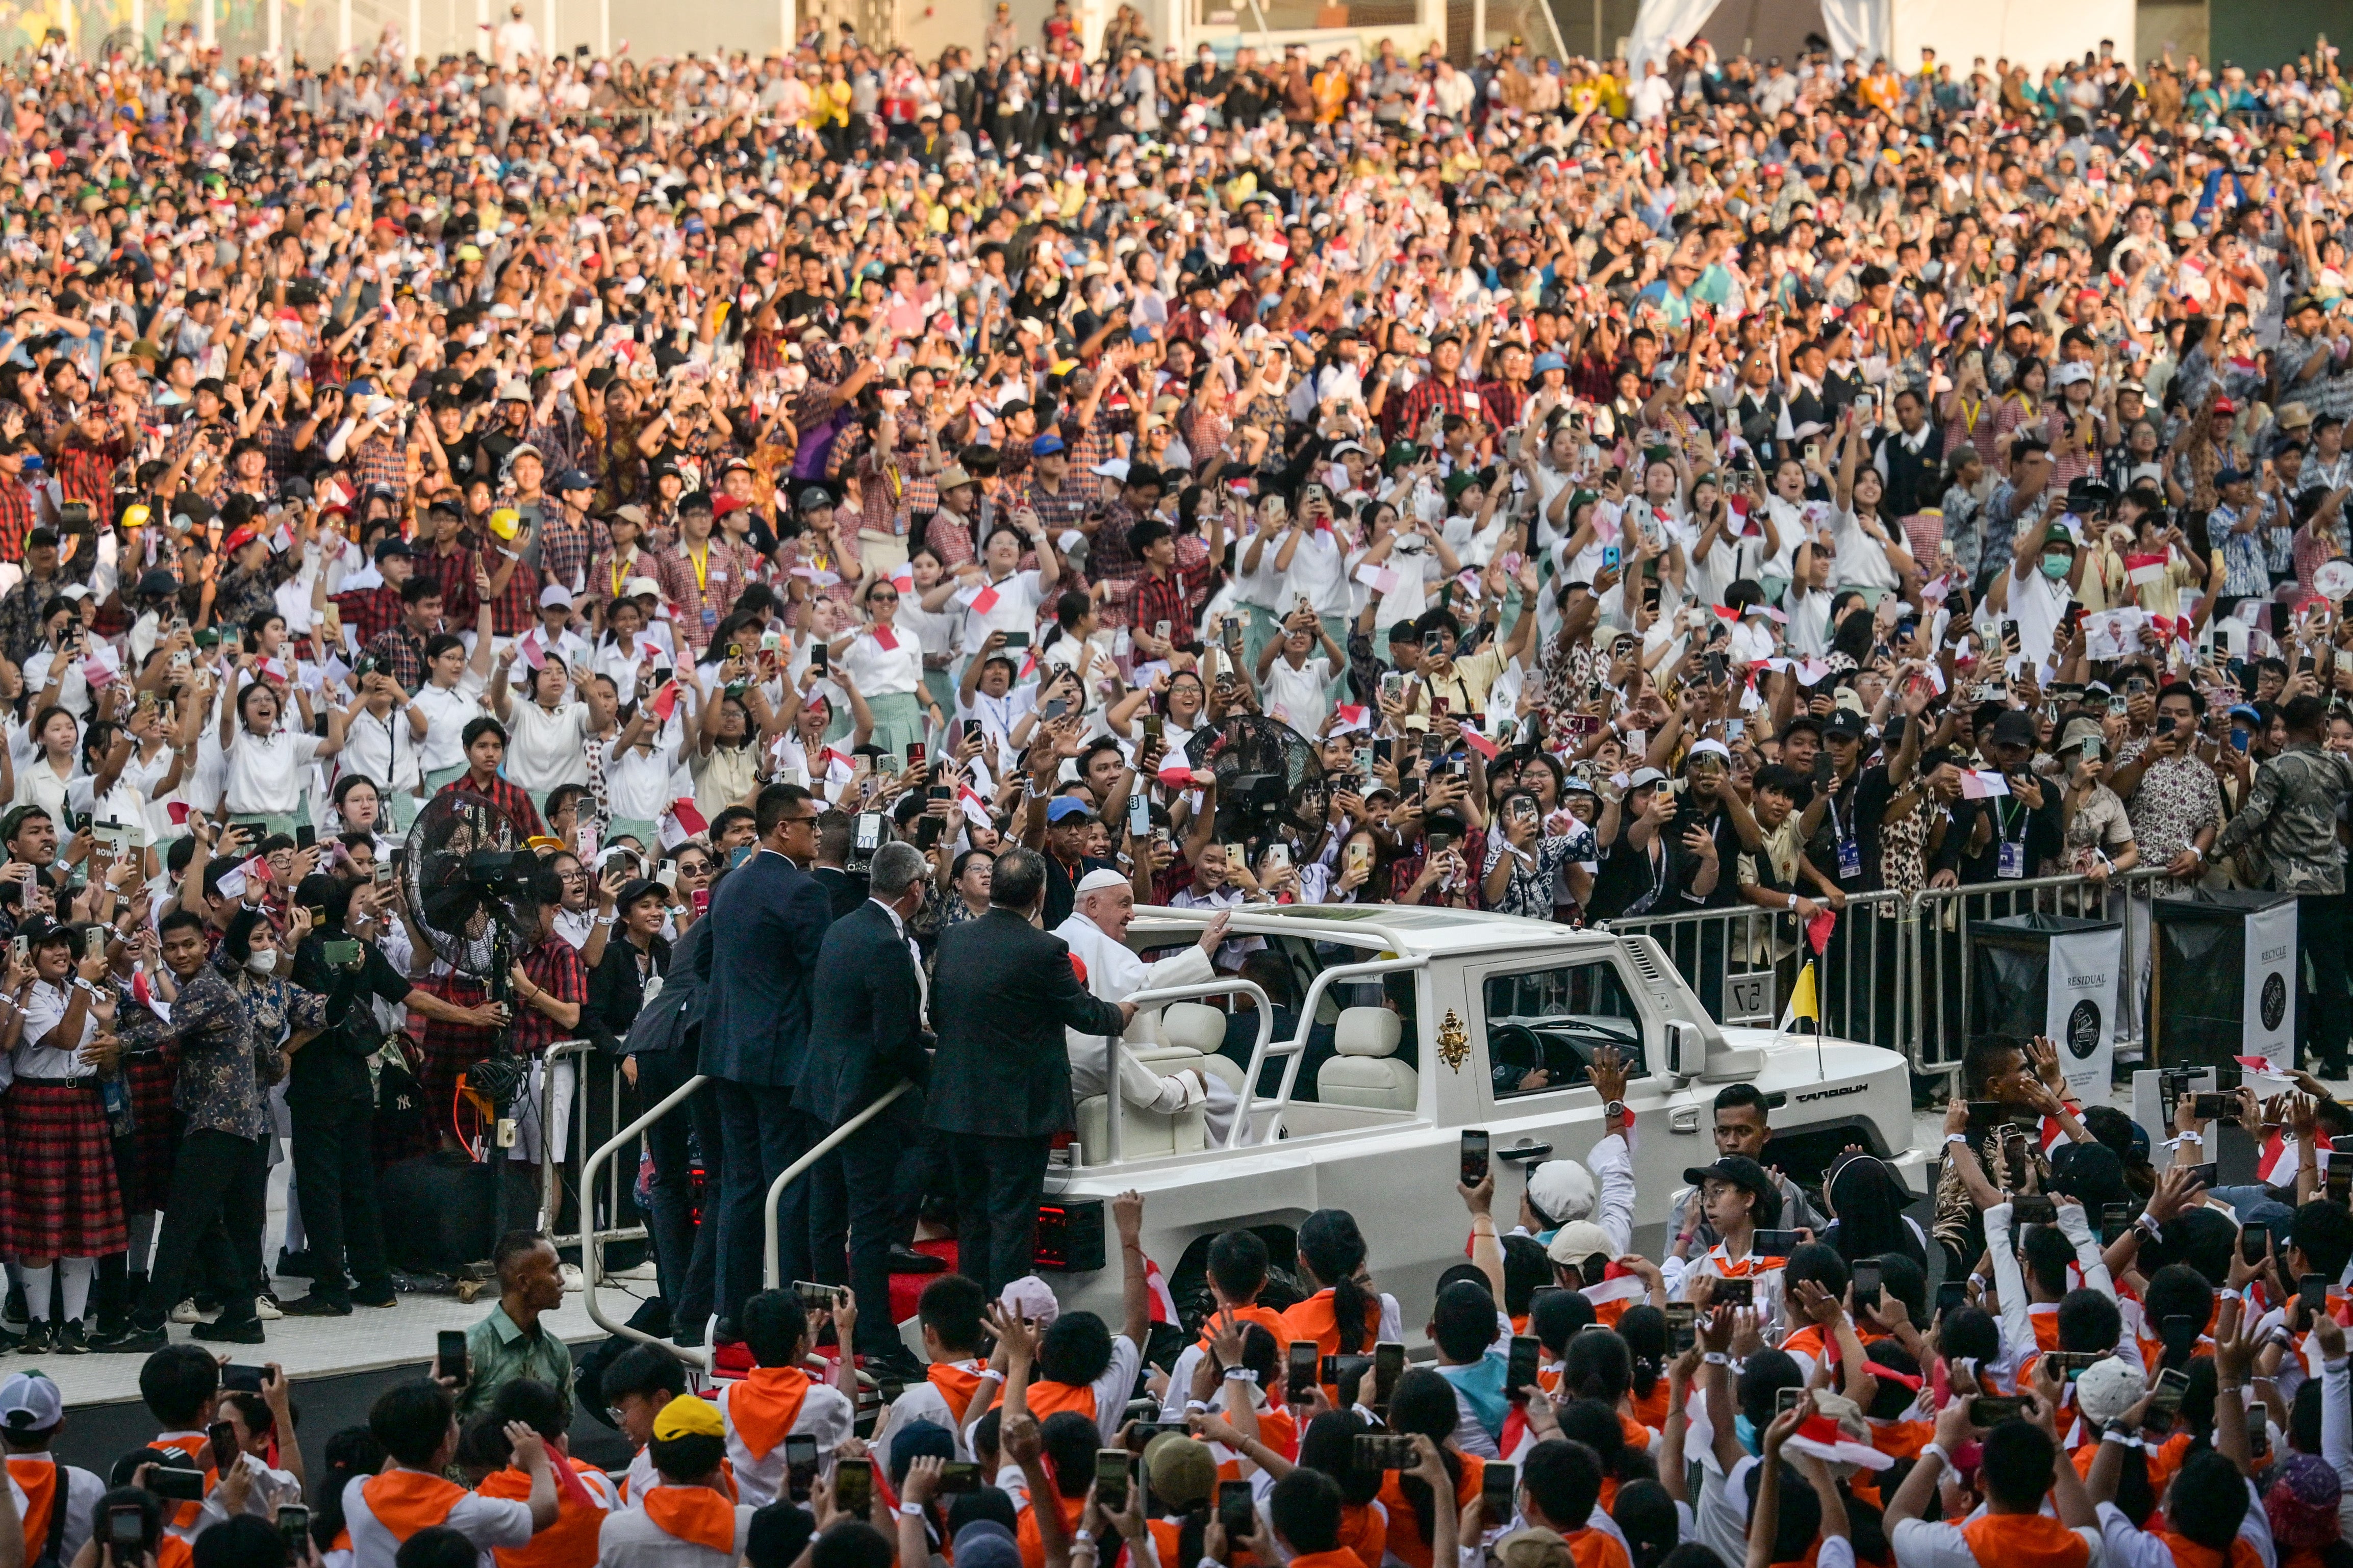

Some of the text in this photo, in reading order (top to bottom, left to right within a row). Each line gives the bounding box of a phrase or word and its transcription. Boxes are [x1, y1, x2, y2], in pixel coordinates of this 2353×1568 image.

[1835, 712, 1844, 725] LA
[96, 848, 112, 858] ROW
[117, 895, 129, 905] 120
[2262, 946, 2286, 961] RECYCLE
[2067, 974, 2106, 987] RESIDUAL
[396, 1094, 411, 1110] NY
